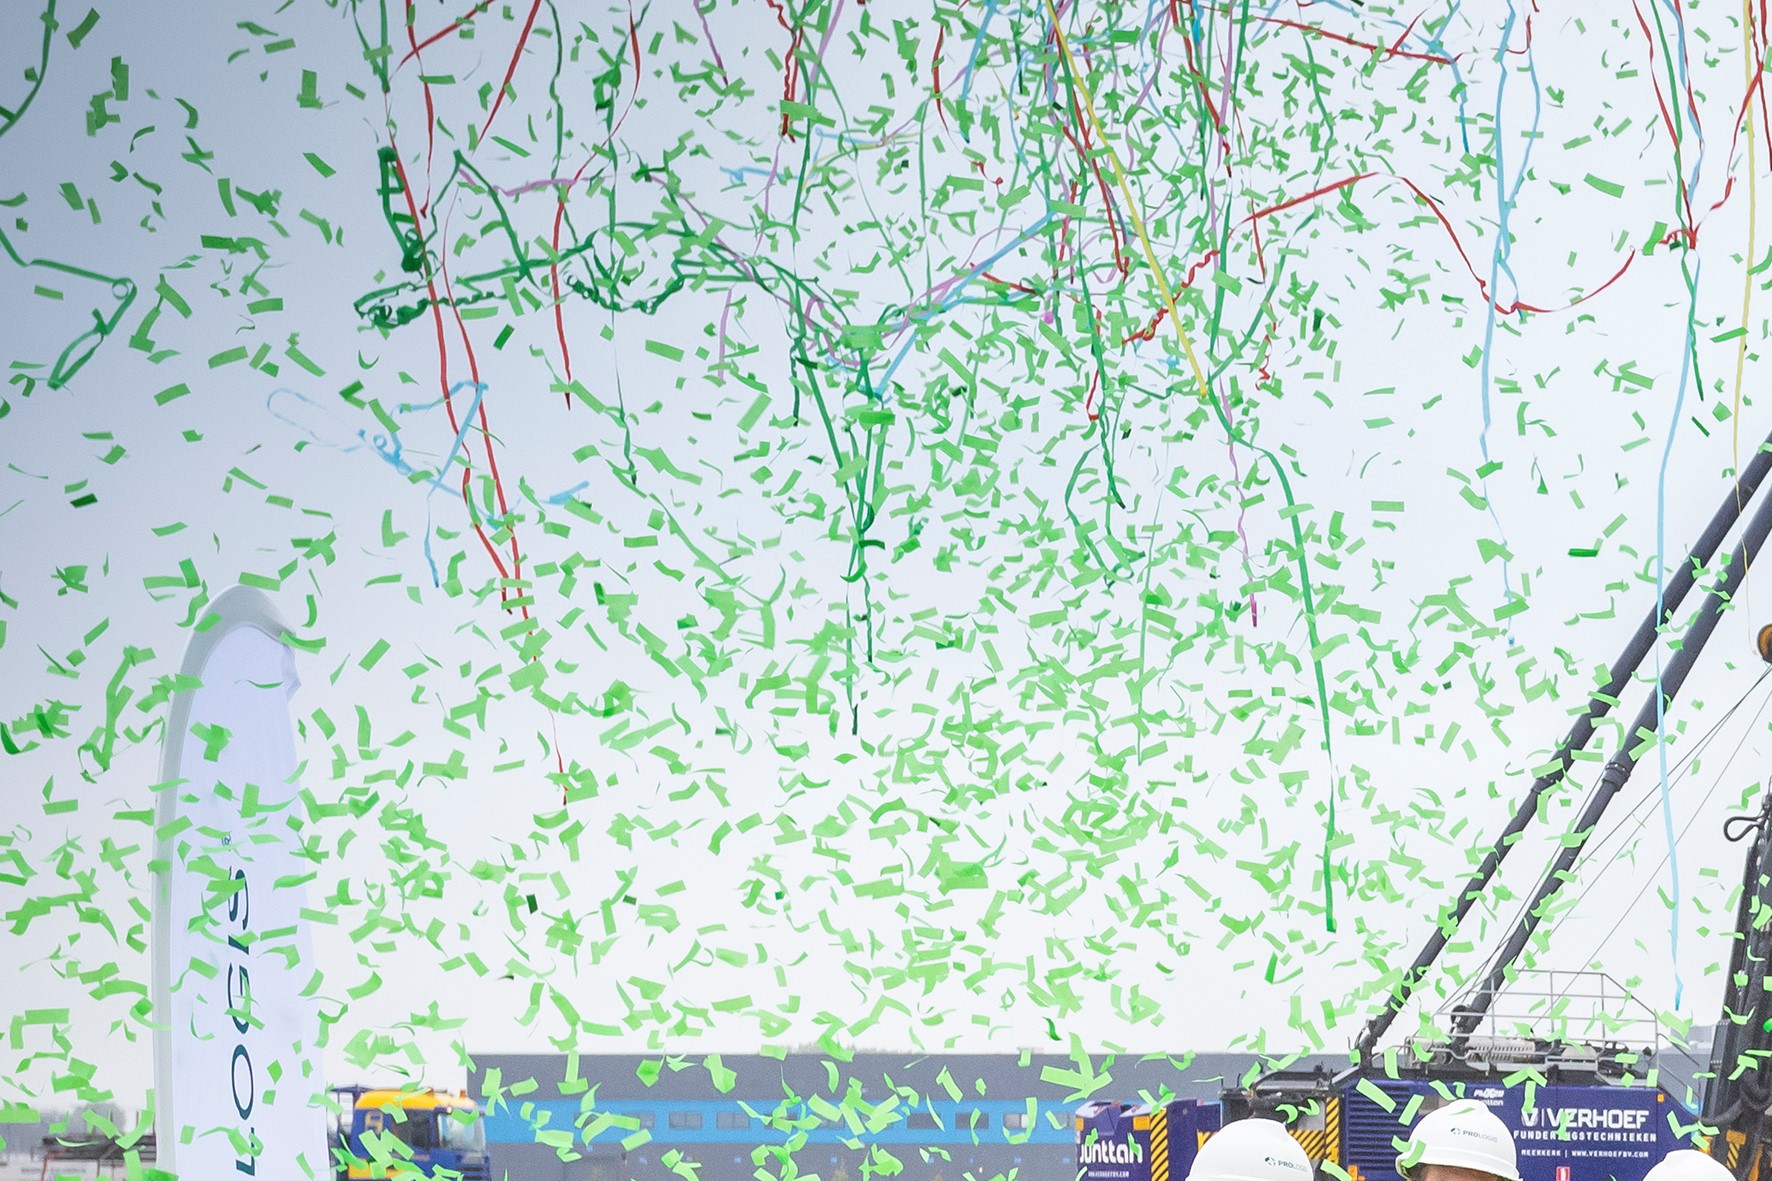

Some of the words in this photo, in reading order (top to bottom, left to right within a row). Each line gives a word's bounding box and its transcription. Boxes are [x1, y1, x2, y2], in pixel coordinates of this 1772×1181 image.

[1547, 1107, 1650, 1129] VERHOEF
[1513, 1130, 1657, 1143] FUNDERGSTECHNIEKEN
[1521, 1149, 1562, 1157] MEERKERK
[1571, 1150, 1649, 1159] WWW.VERHOEFBV.COM
